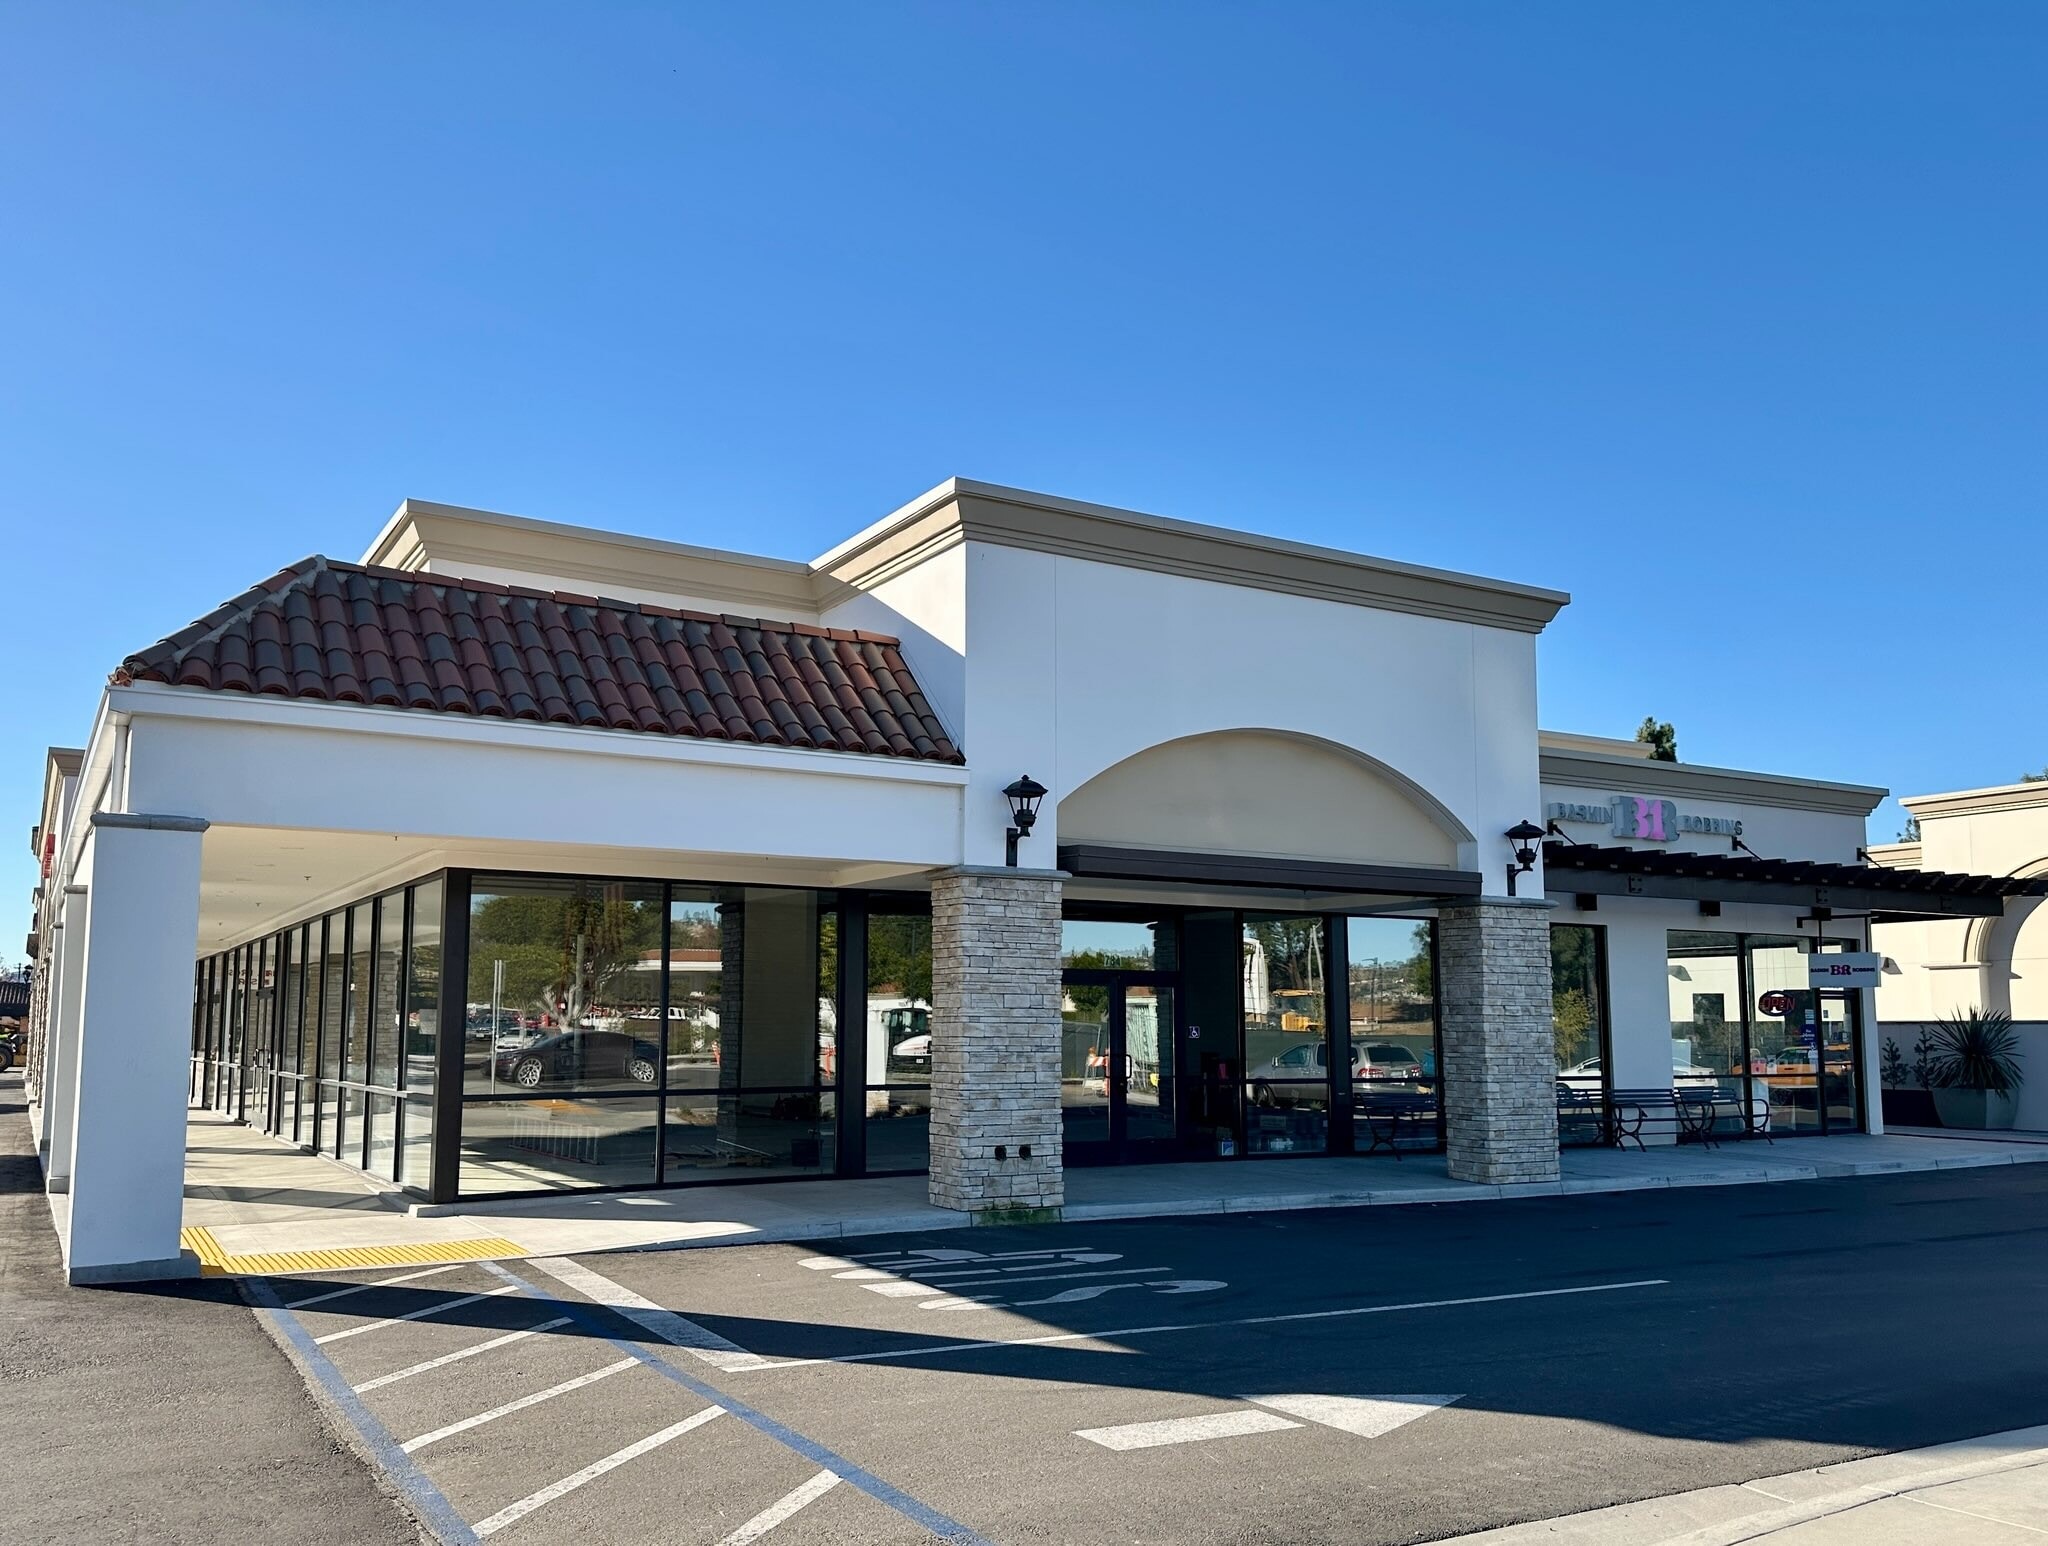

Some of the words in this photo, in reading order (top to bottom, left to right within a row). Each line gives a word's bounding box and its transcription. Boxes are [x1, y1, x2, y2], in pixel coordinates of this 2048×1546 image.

[1548, 802, 1613, 824] BASKIN
[1677, 815, 1743, 836] ROBBINS
[1762, 997, 1796, 1010] OPEN
[797, 1247, 1229, 1311] STOP
